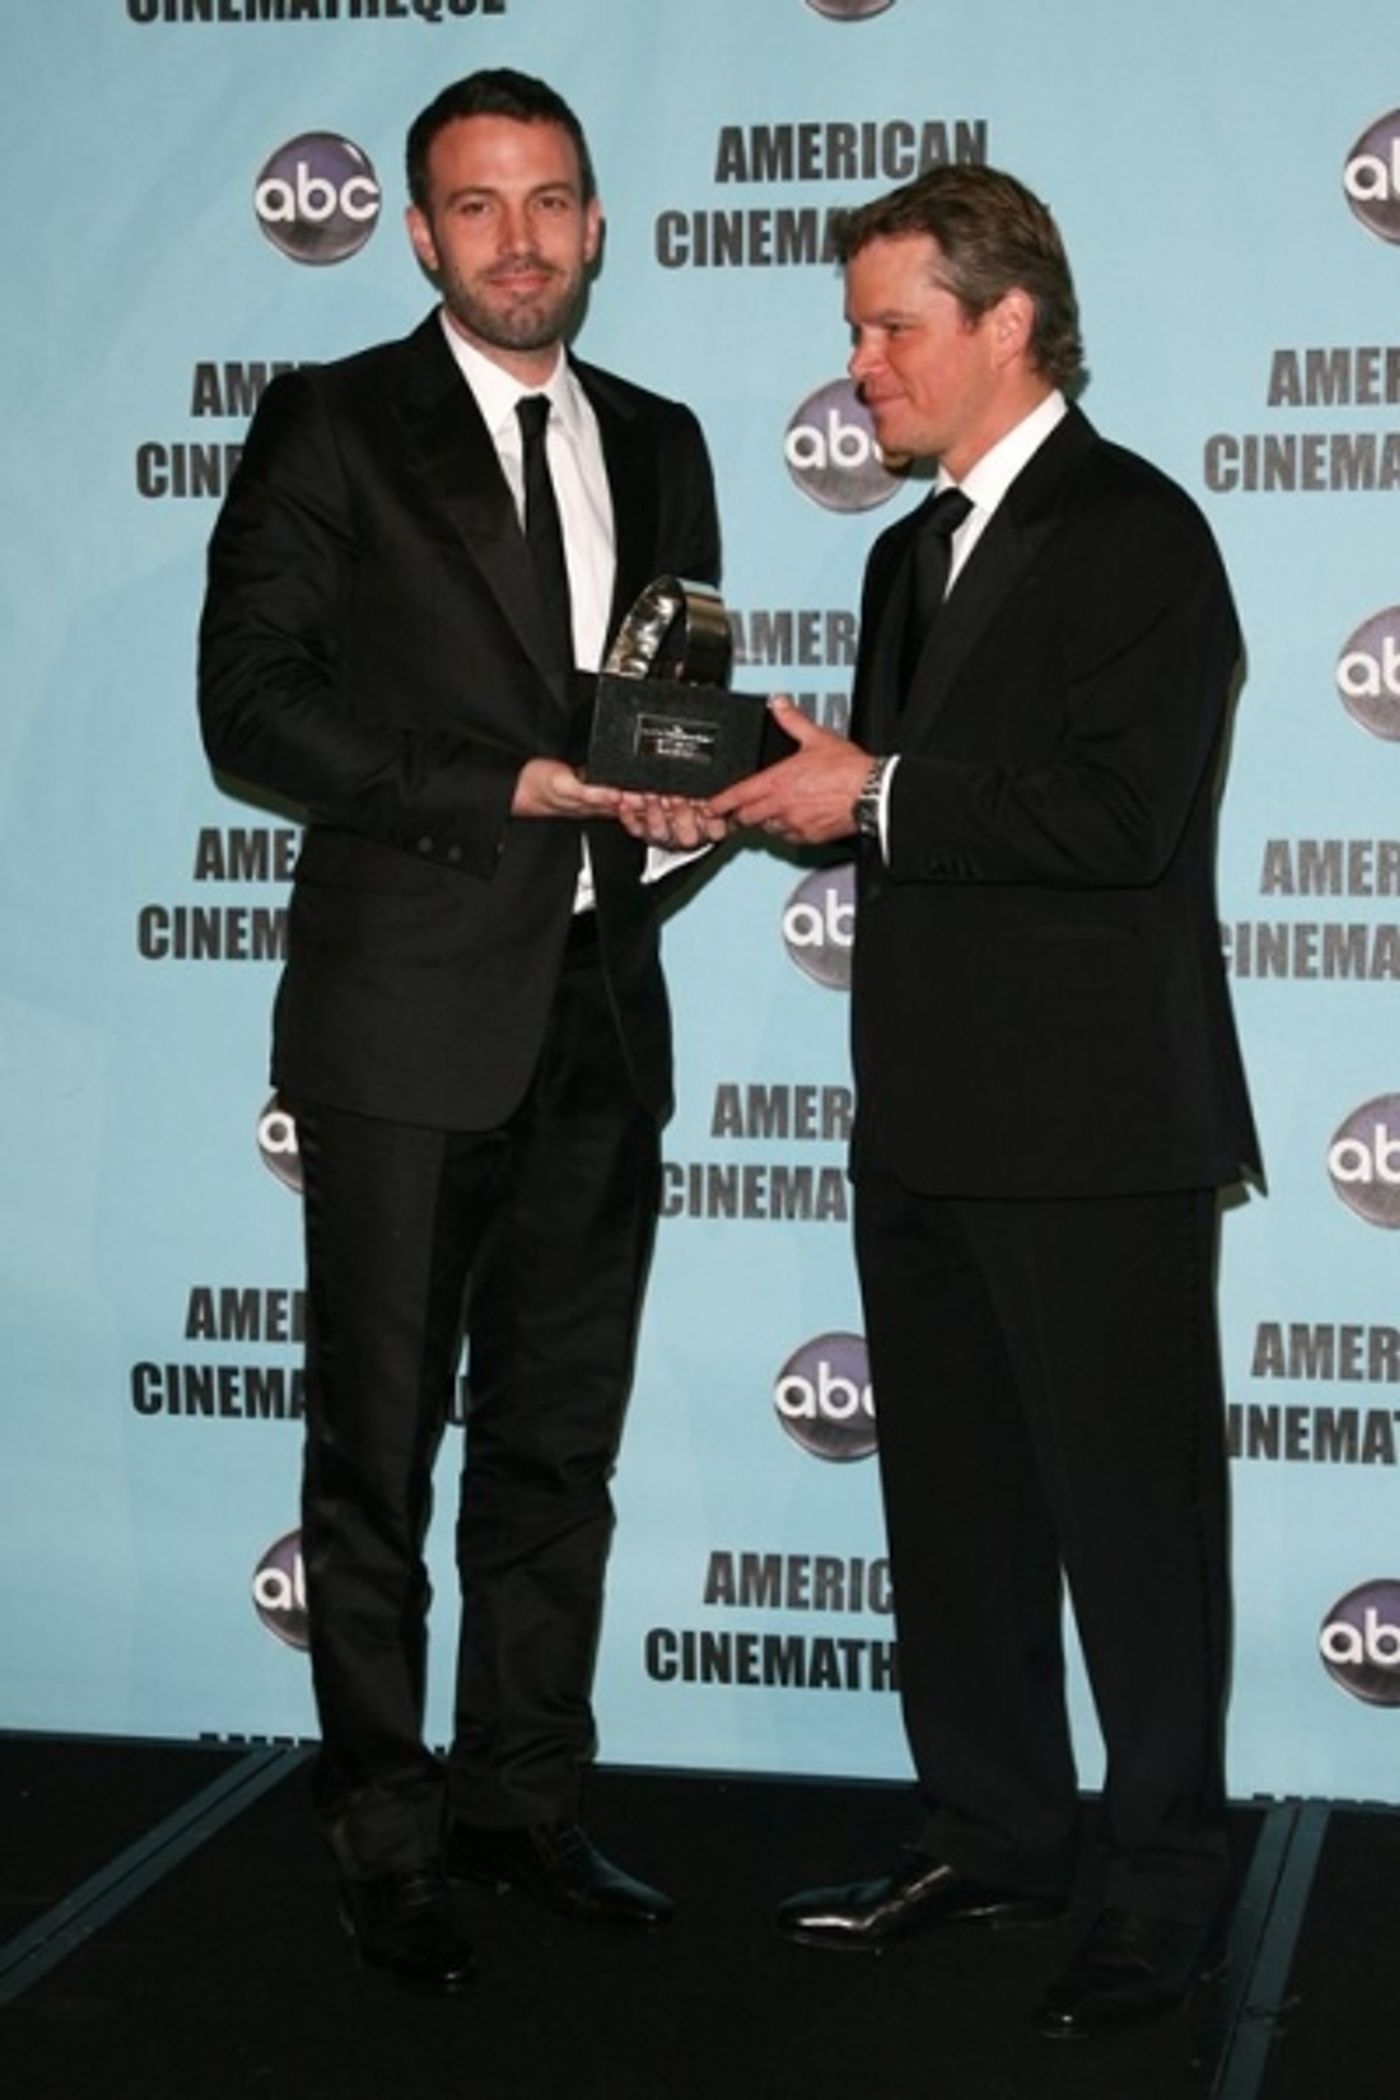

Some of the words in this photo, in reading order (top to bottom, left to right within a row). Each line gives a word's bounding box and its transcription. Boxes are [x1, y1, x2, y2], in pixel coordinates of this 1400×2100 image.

[714, 119, 987, 183] AMERICAN
[1344, 137, 1400, 200] a
[256, 161, 379, 222] abc
[784, 409, 883, 468] ab
[193, 827, 297, 882] AME
[1260, 839, 1400, 896] AMER
[138, 904, 289, 961] CINEM
[710, 1083, 853, 1139] AMER
[1251, 1322, 1400, 1383] AMER
[776, 1361, 876, 1420] ab
[255, 1553, 306, 1611] a
[703, 1550, 895, 1615] AMERIC
[644, 1627, 899, 1693] CINEMATH
[1320, 1608, 1400, 1665] ab
